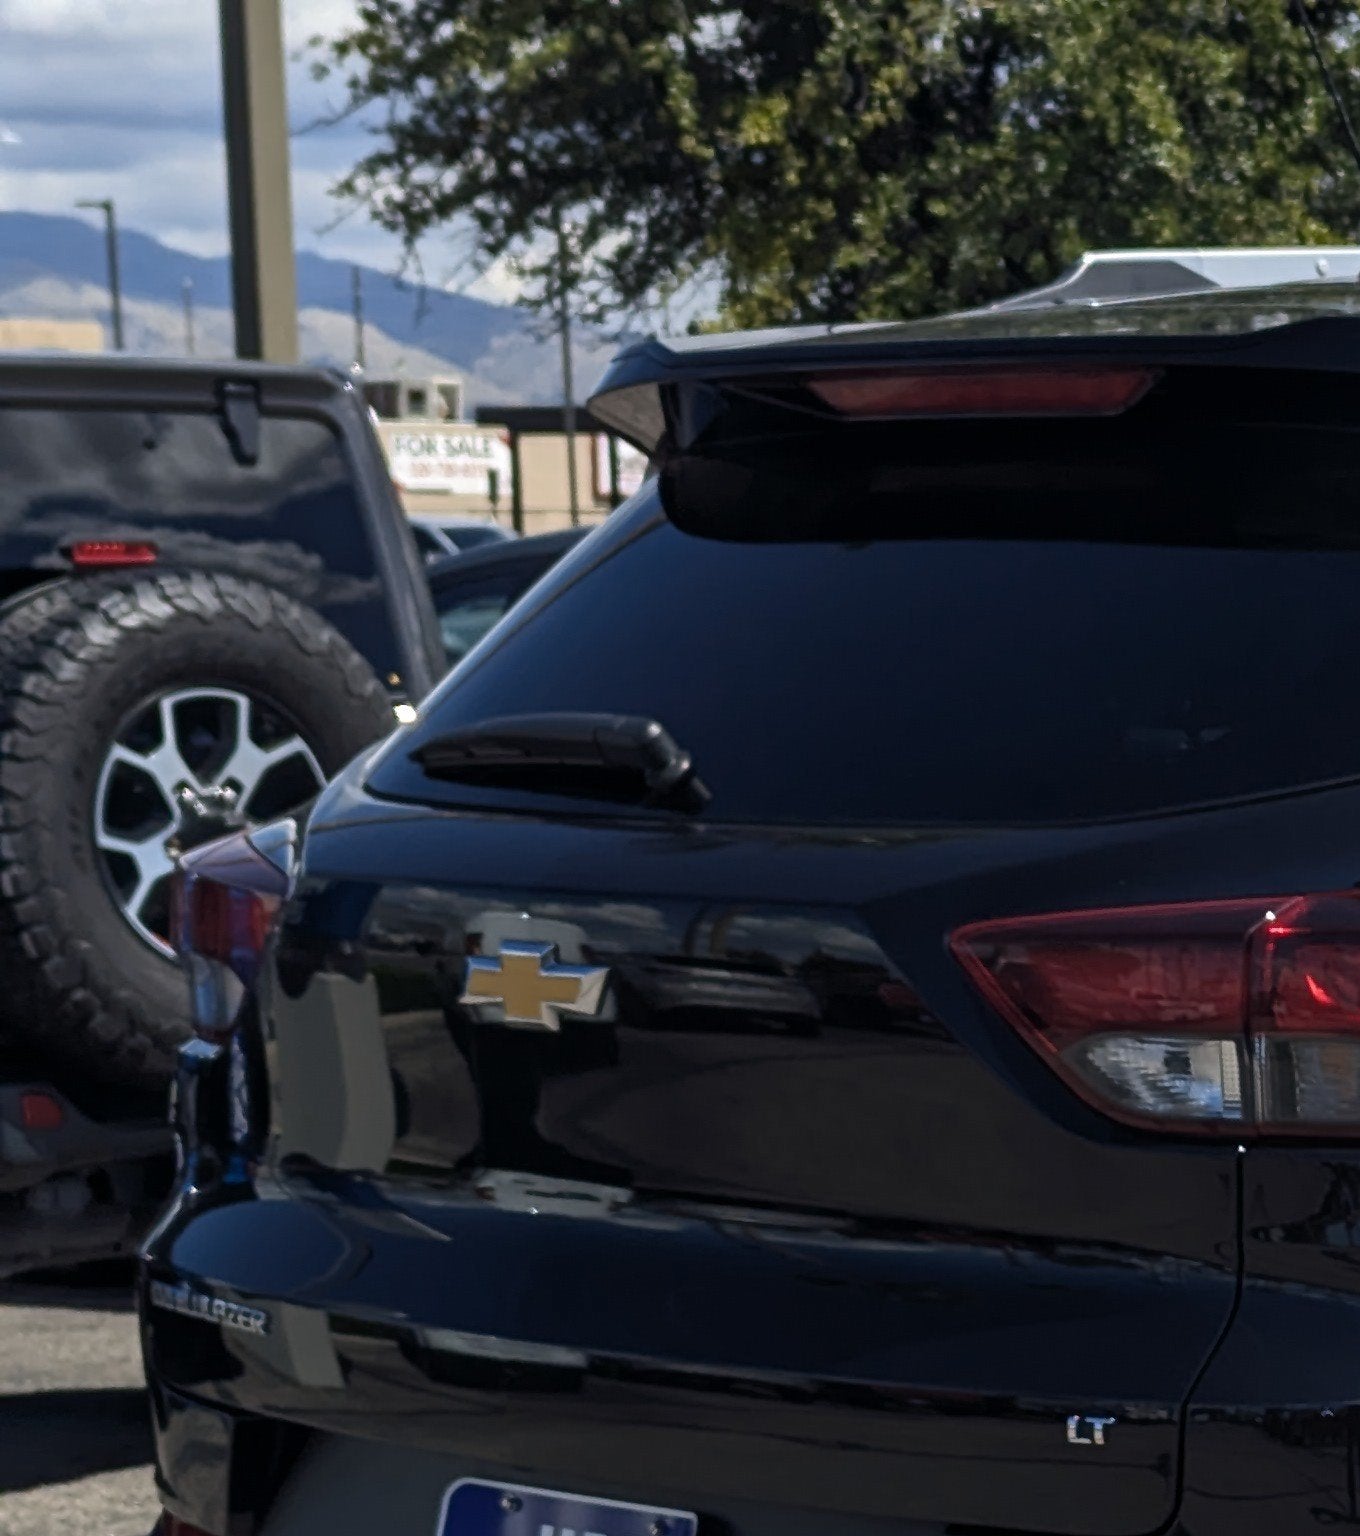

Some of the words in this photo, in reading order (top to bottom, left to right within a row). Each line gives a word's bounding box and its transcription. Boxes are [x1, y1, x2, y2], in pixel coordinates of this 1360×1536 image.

[394, 435, 437, 457] FOR
[446, 435, 494, 458] SALE
[1067, 1414, 1116, 1445] LT
